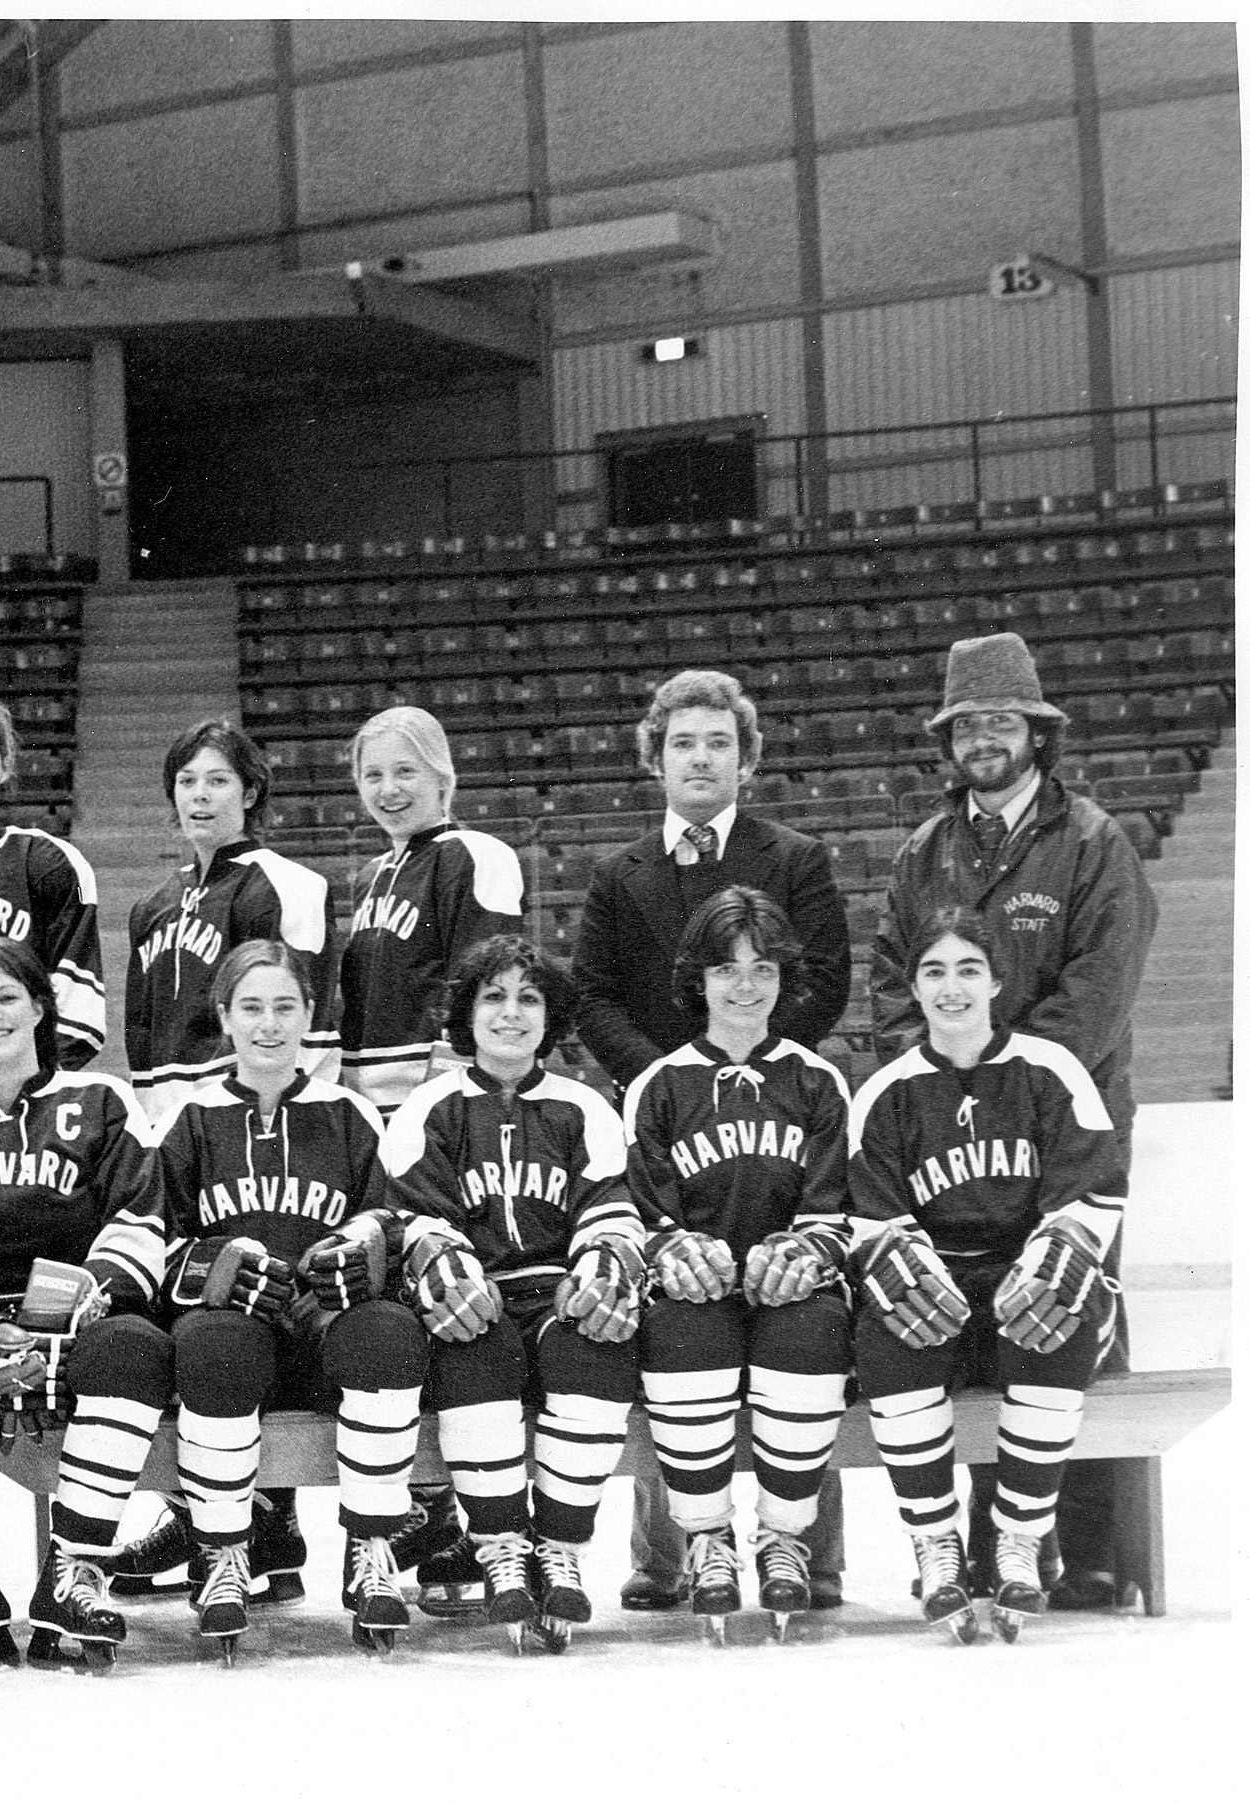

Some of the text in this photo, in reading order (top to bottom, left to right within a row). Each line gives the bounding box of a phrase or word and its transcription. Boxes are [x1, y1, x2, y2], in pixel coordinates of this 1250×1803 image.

[1001, 266, 1042, 295] 13
[1003, 892, 1060, 915] HARVARD
[1011, 917, 1050, 932] STAFF
[56, 1102, 82, 1141] C
[670, 1119, 807, 1179] HARVAR
[199, 1175, 347, 1228] HARVARD
[457, 1160, 569, 1213] ARVAR
